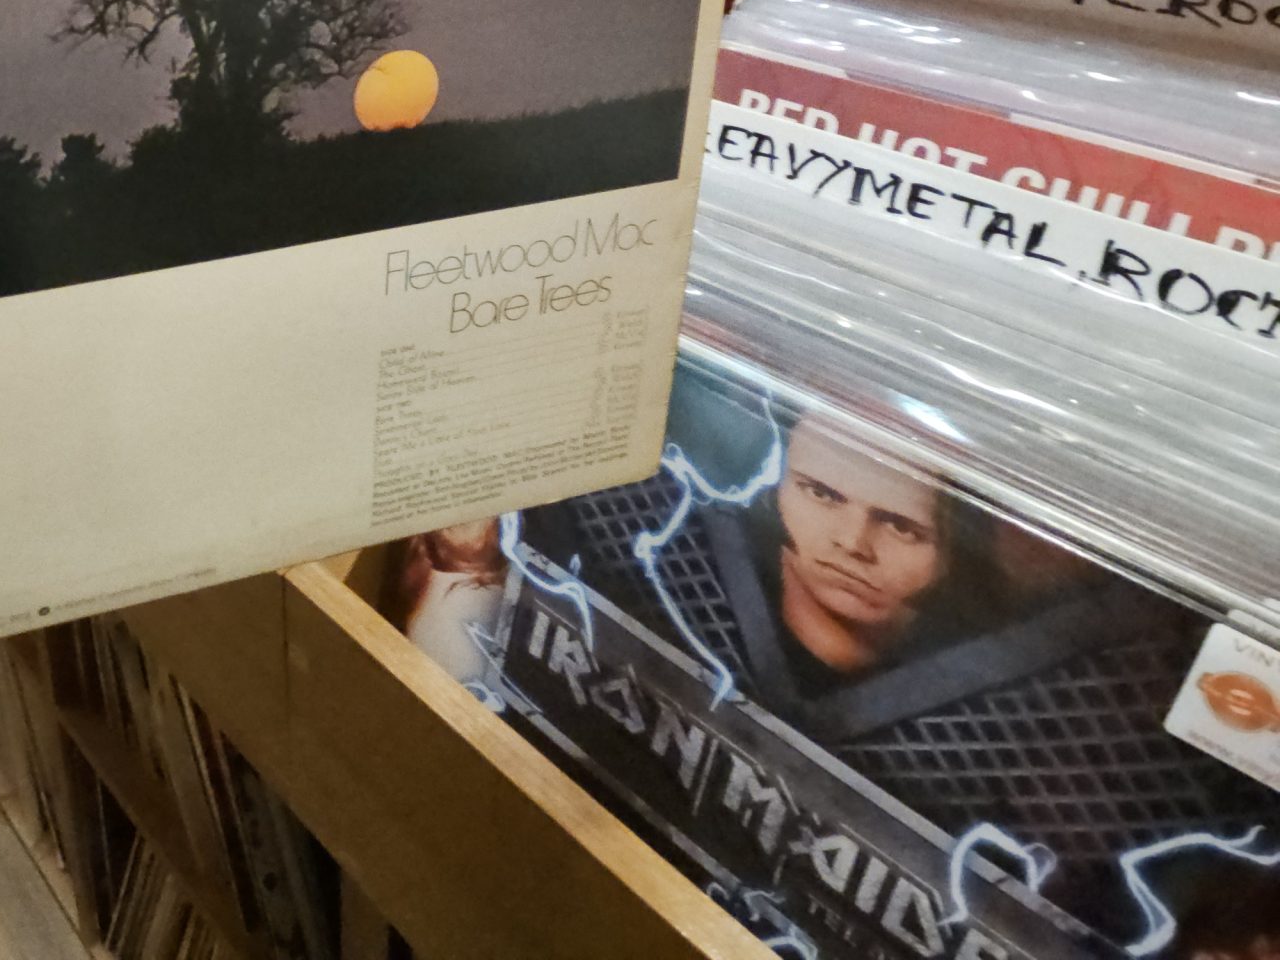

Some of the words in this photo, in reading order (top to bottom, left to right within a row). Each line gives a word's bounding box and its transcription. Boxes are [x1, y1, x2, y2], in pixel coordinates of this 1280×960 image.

[384, 219, 580, 296] Fleetwood
[583, 212, 657, 258] Mac
[449, 291, 530, 334] Bare
[535, 273, 613, 316] Trees
[527, 610, 707, 790] IRON
